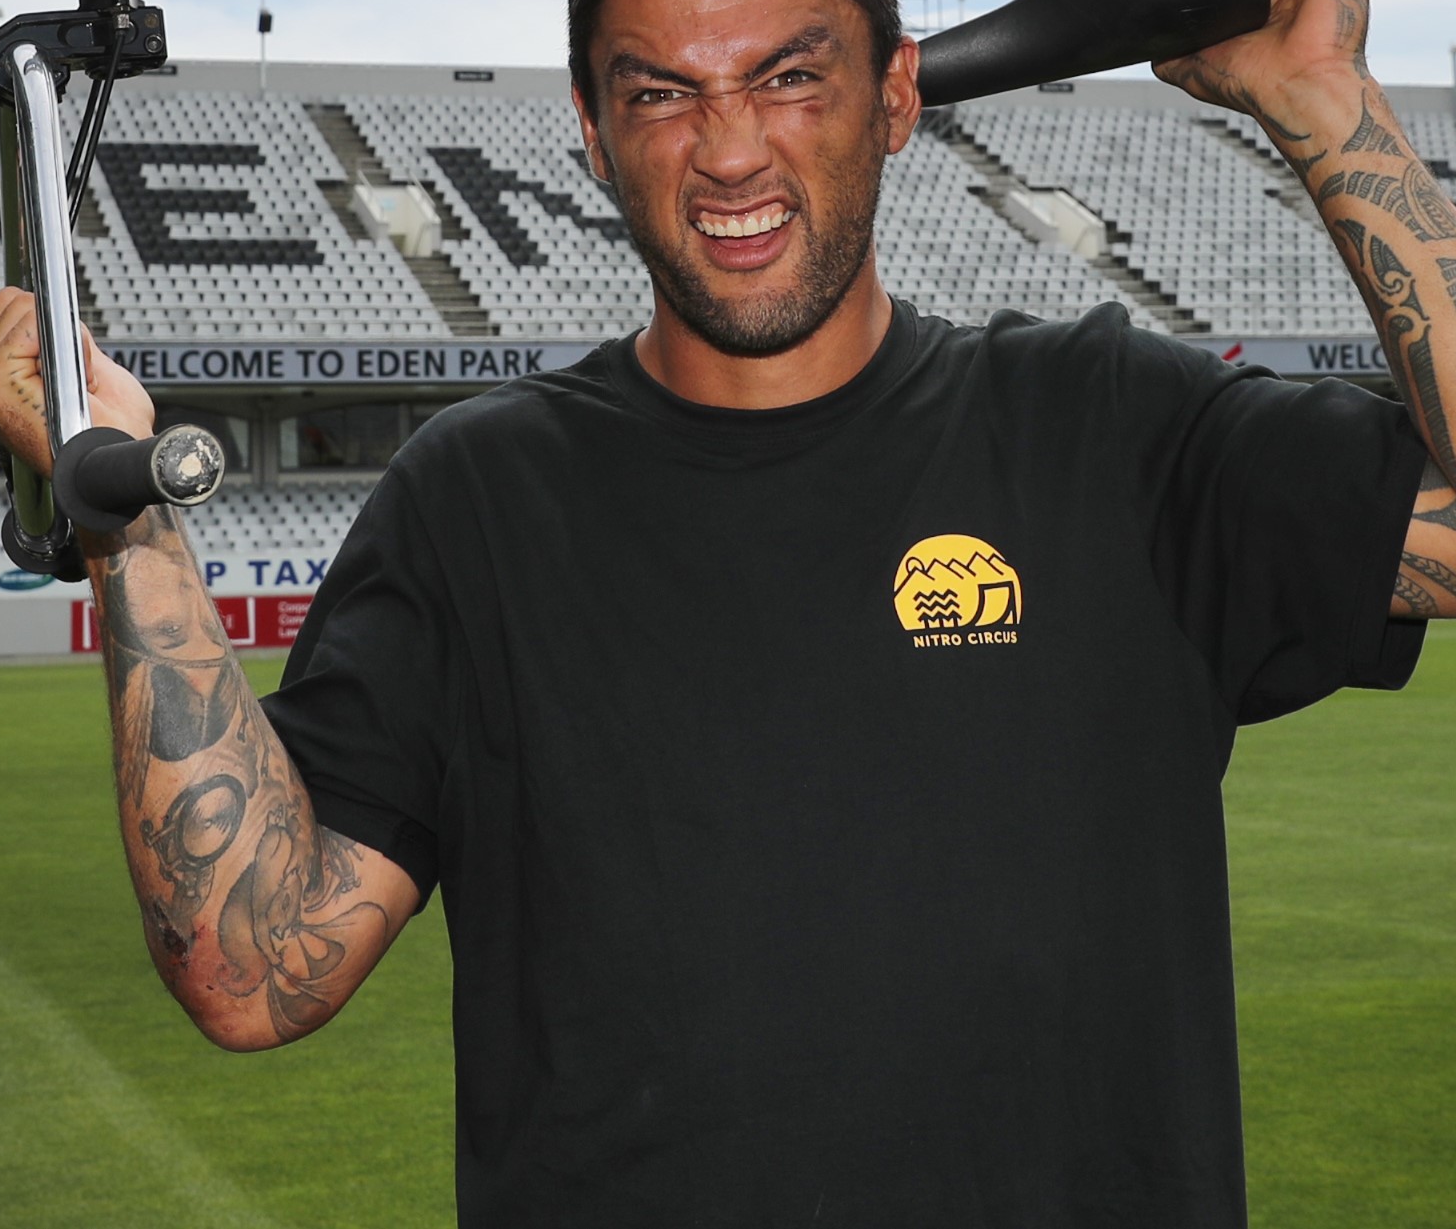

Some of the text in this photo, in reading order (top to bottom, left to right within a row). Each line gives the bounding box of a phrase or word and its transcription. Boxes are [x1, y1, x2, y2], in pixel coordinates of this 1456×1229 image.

[111, 347, 544, 380] WELCOME TO EDEN PARK
[1307, 343, 1389, 371] WELC
[247, 559, 329, 587] TAX
[913, 630, 1019, 649] NITRO CIRCUS
